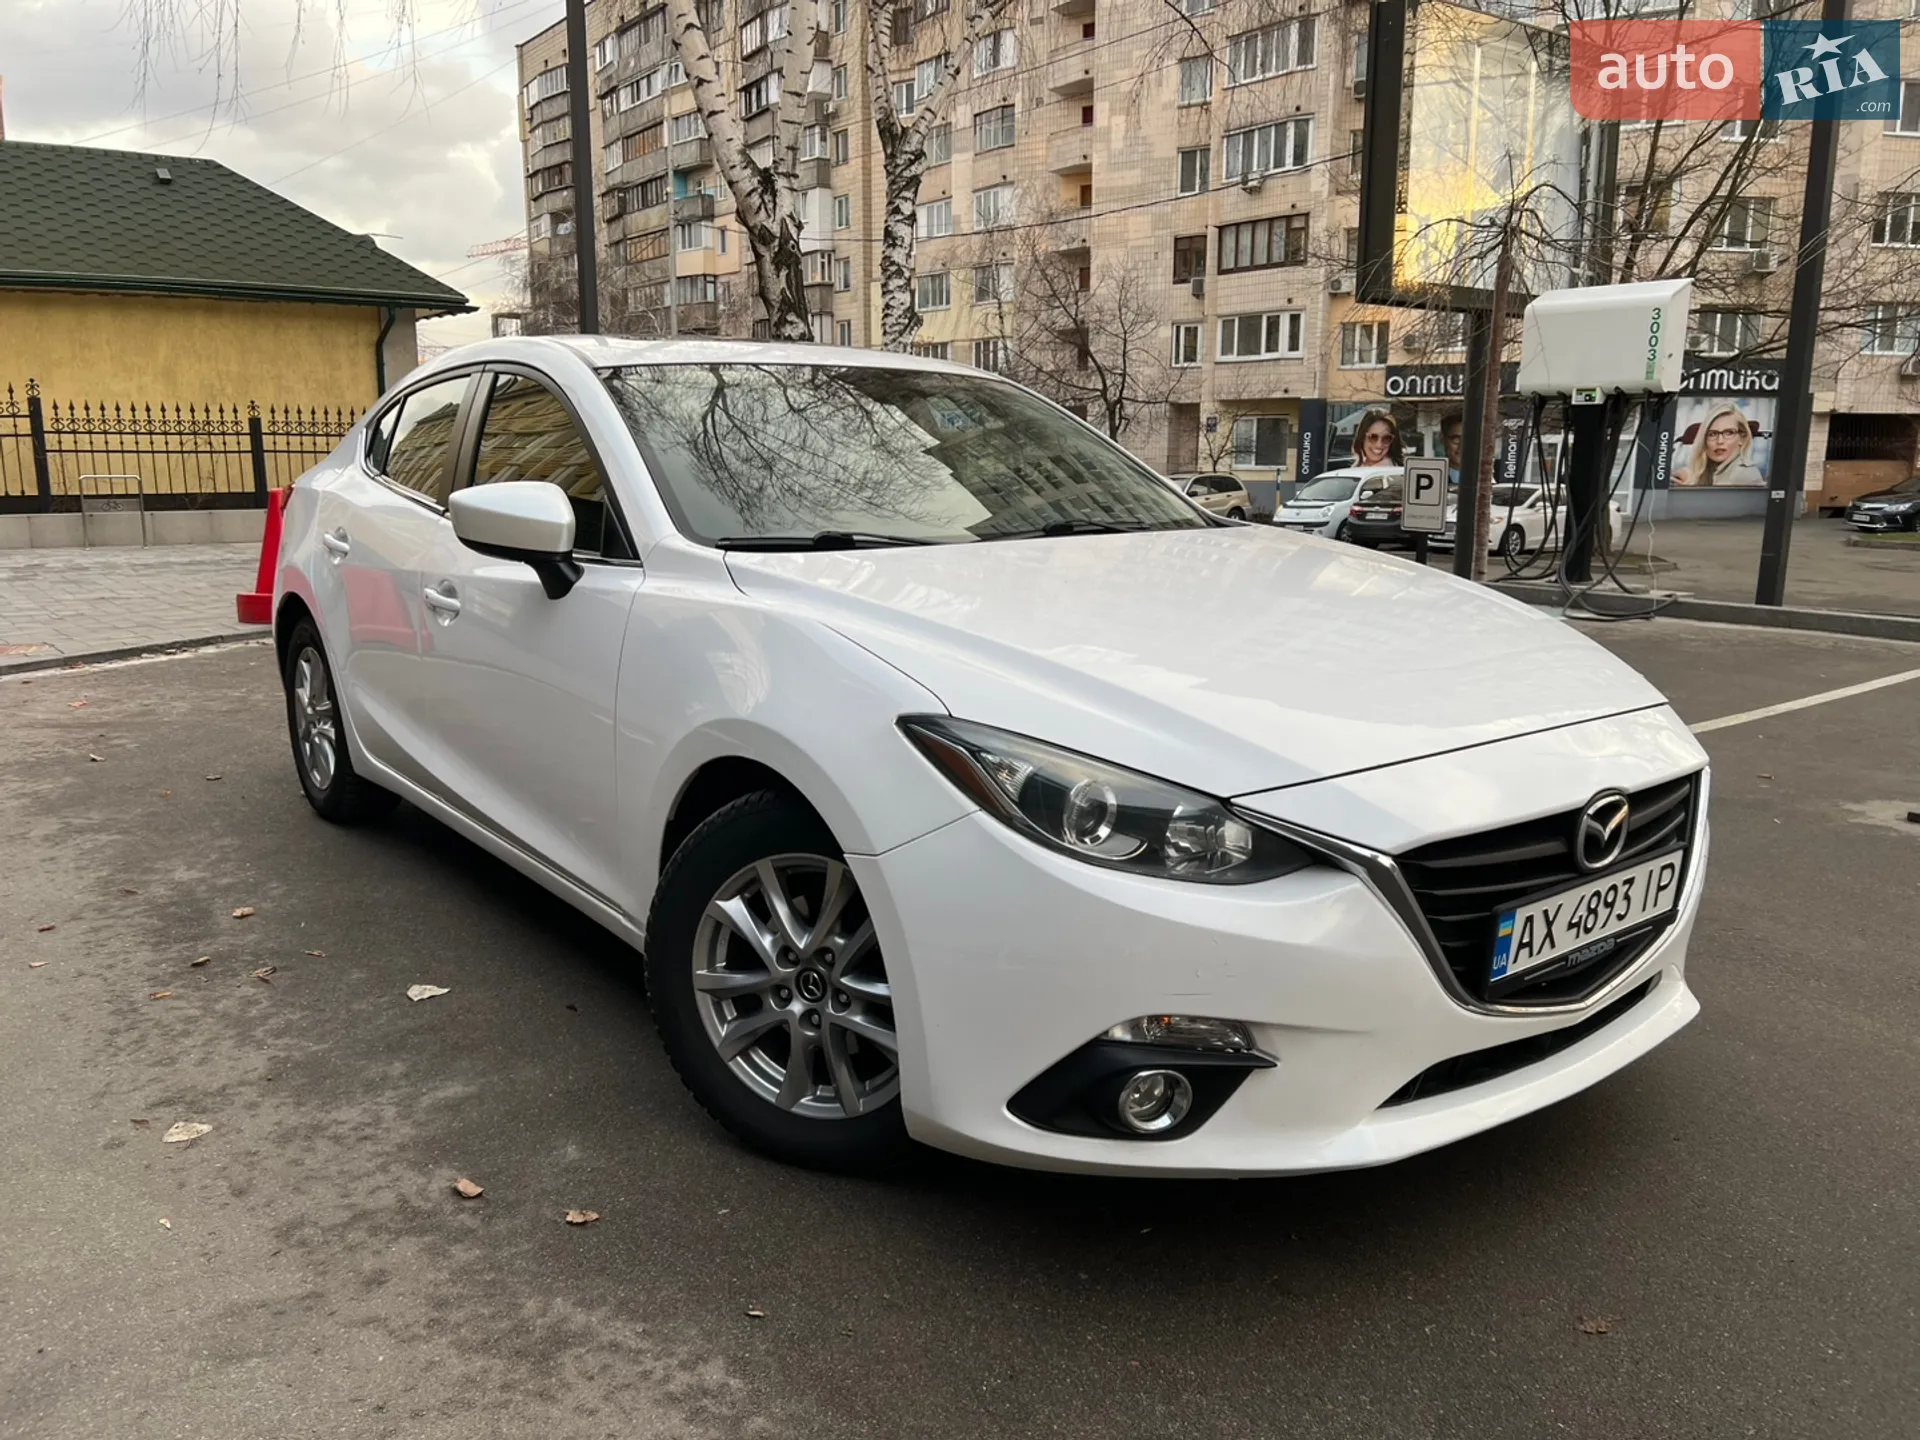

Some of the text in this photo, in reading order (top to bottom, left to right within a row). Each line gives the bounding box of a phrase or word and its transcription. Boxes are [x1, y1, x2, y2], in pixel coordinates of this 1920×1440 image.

[1647, 307, 1662, 361] 3003
[1415, 473, 1434, 499] P
[1512, 861, 1676, 965] AX 4893 IP
[1492, 952, 1507, 970] UA
